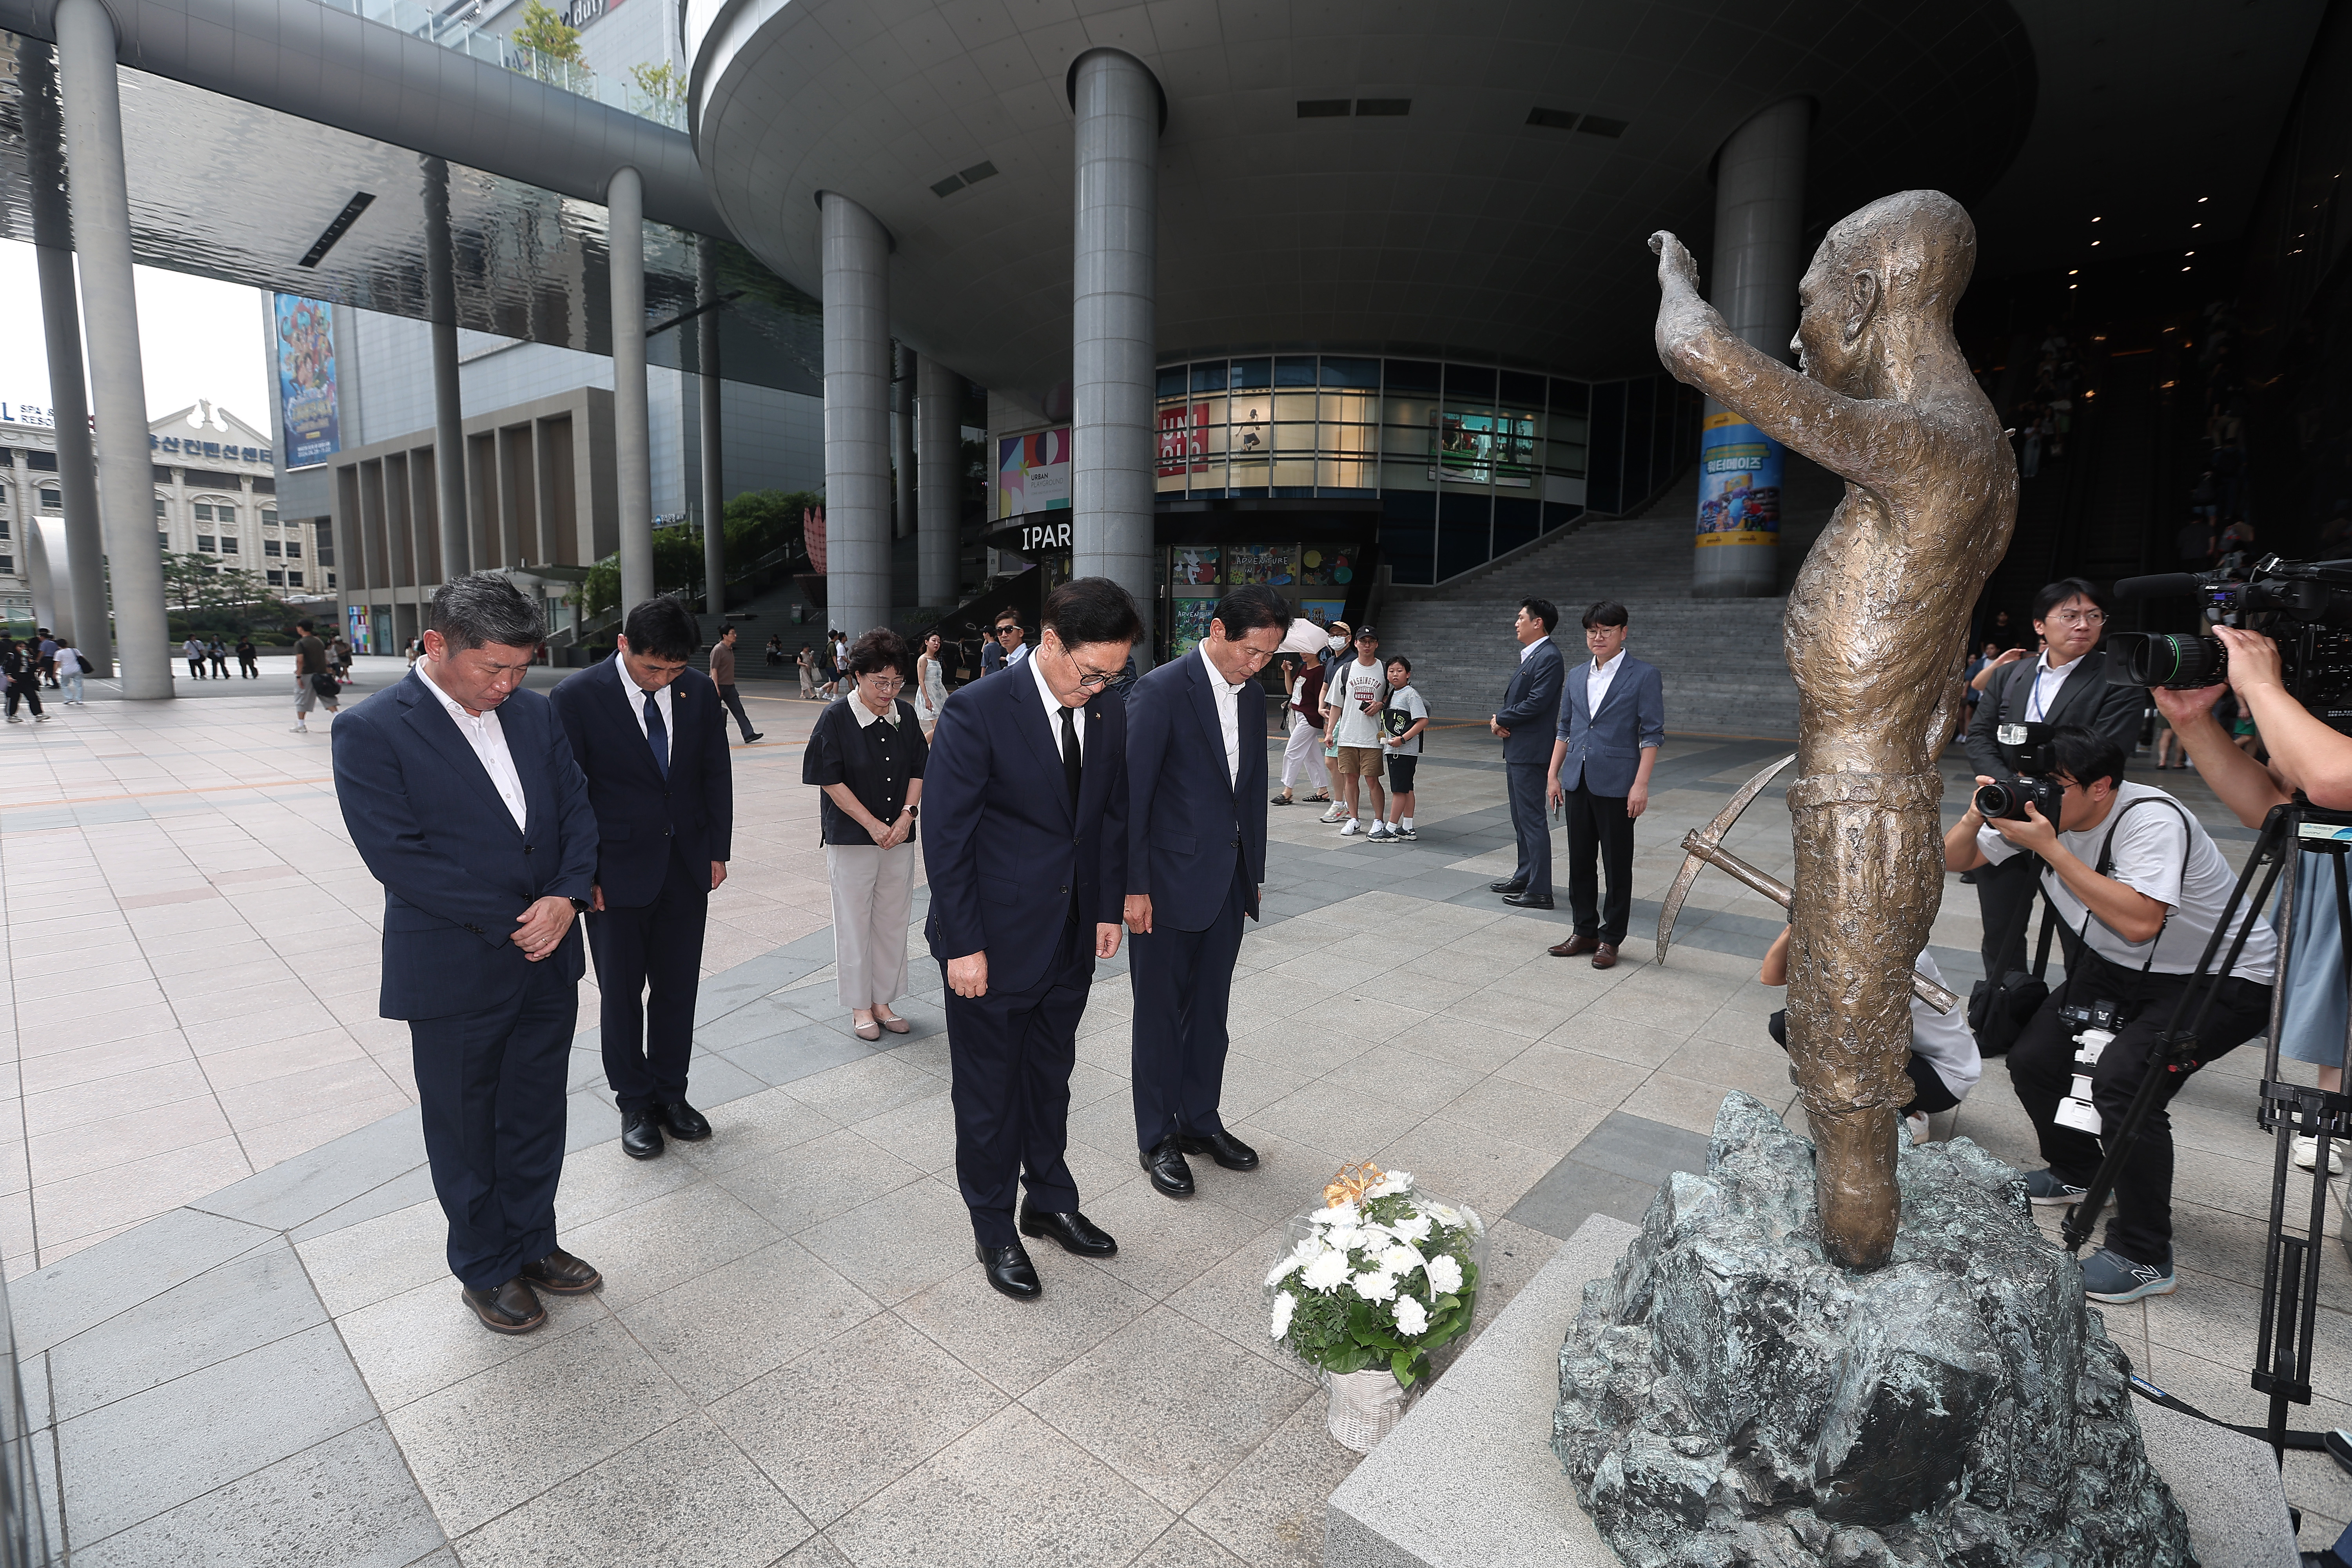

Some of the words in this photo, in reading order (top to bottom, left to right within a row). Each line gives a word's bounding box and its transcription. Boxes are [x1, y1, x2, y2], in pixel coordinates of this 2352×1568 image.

[20, 405, 41, 415] SPA
[1163, 414, 1198, 440] UNI
[1162, 441, 1200, 470] QLO
[1708, 457, 1761, 472] 워터메이즈
[1031, 472, 1048, 481] URBAN
[1031, 477, 1063, 488] PLAYGROUND
[1236, 556, 1288, 564] ADVENTURE
[1349, 676, 1381, 689] WASHINGTON
[1394, 715, 1405, 734] FILA
